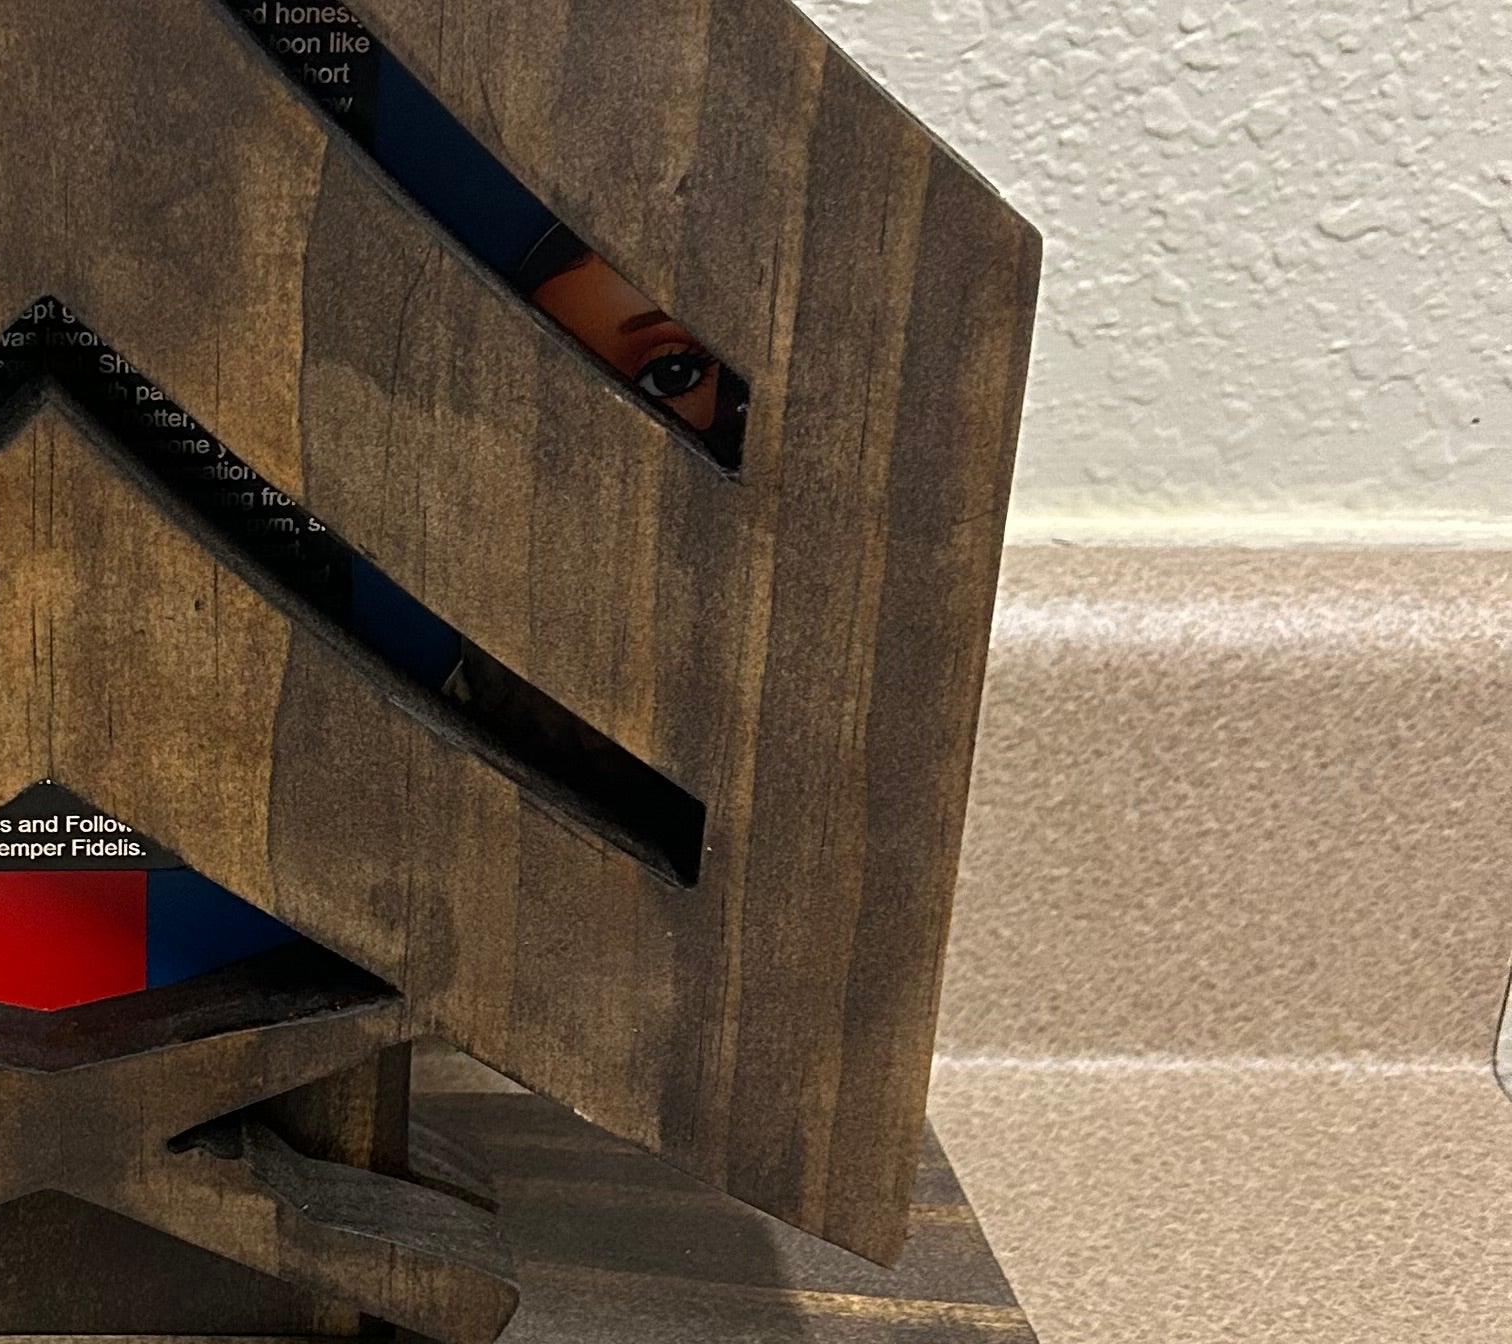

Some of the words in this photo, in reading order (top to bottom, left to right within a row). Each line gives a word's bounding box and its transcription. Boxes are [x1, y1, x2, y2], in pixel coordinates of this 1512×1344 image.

[329, 32, 371, 55] like
[18, 816, 58, 833] and
[71, 838, 147, 857] Fidelis.
